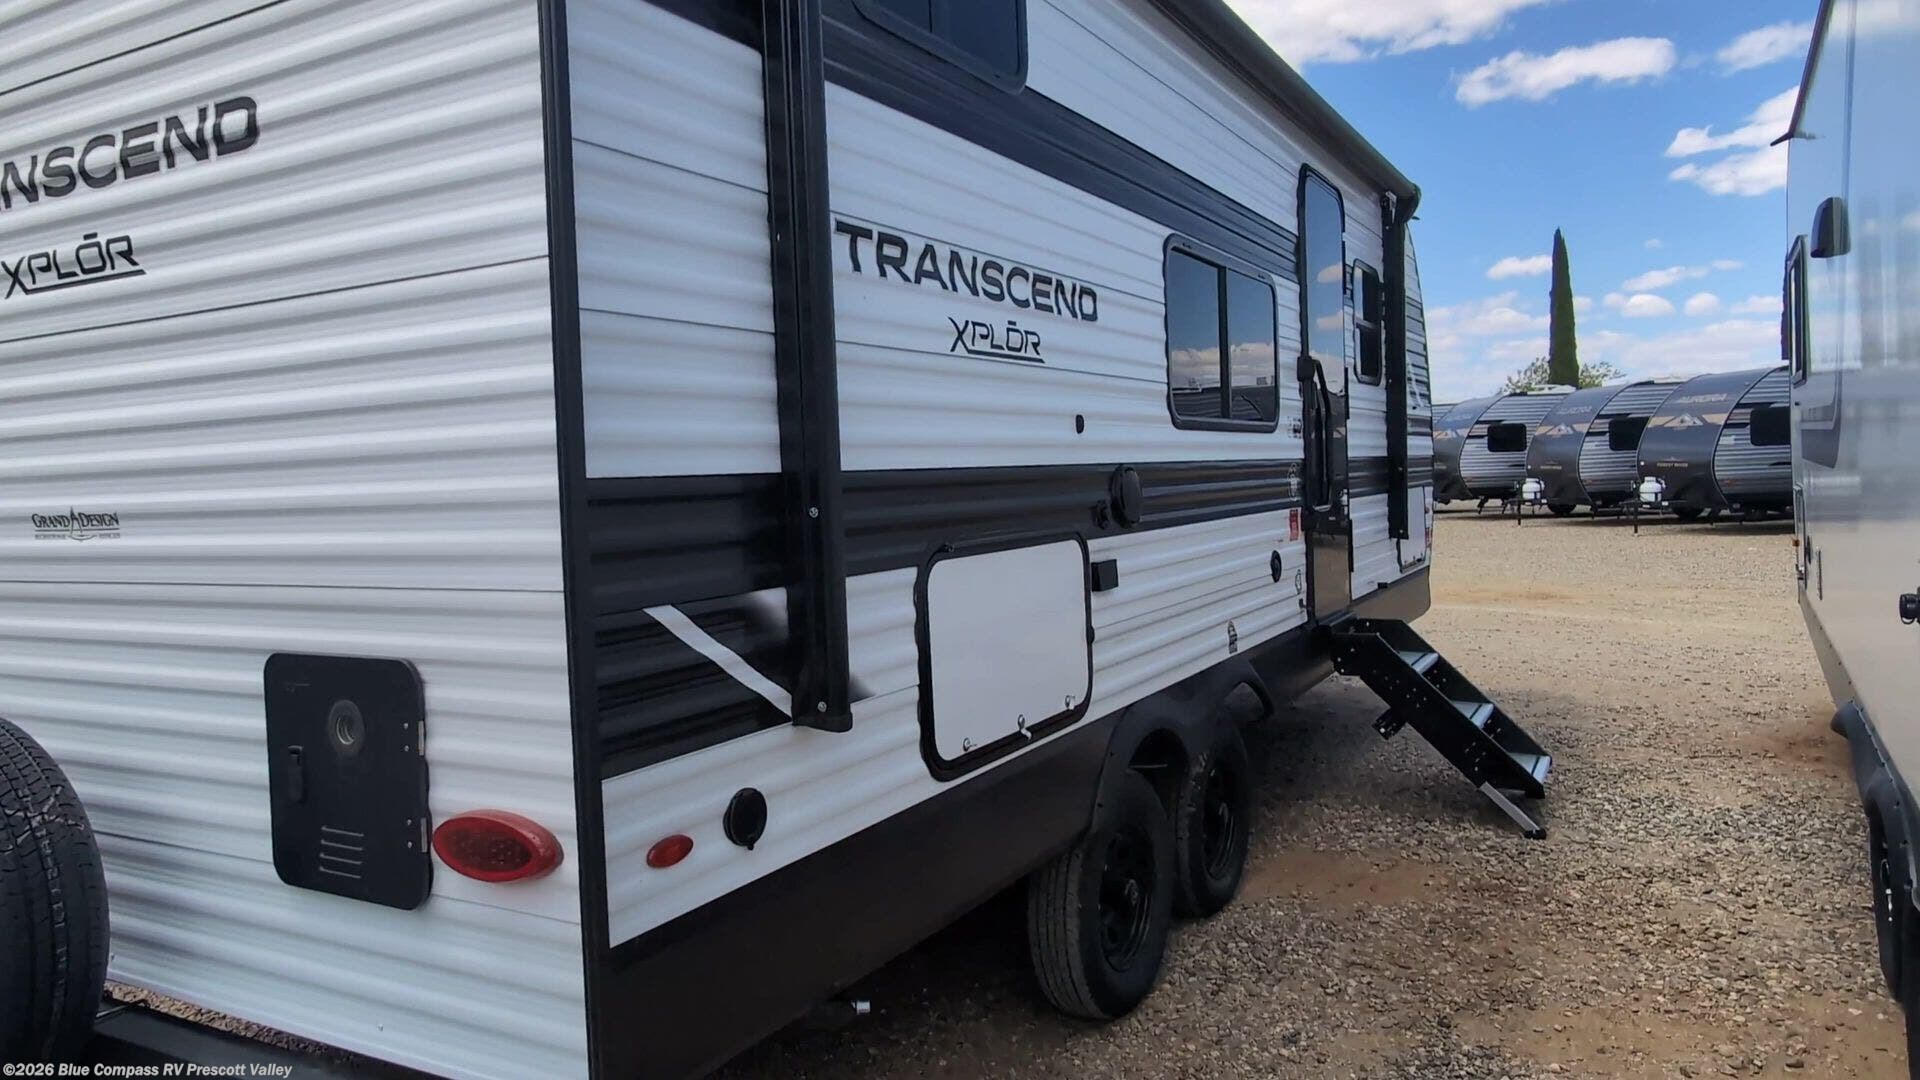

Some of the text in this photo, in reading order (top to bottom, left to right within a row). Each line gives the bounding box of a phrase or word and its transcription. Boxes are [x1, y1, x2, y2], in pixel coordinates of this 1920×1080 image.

[0, 96, 260, 209] NSCEND
[835, 219, 1098, 322] TRANSCEND
[31, 511, 119, 528] GRAND DESIGN
